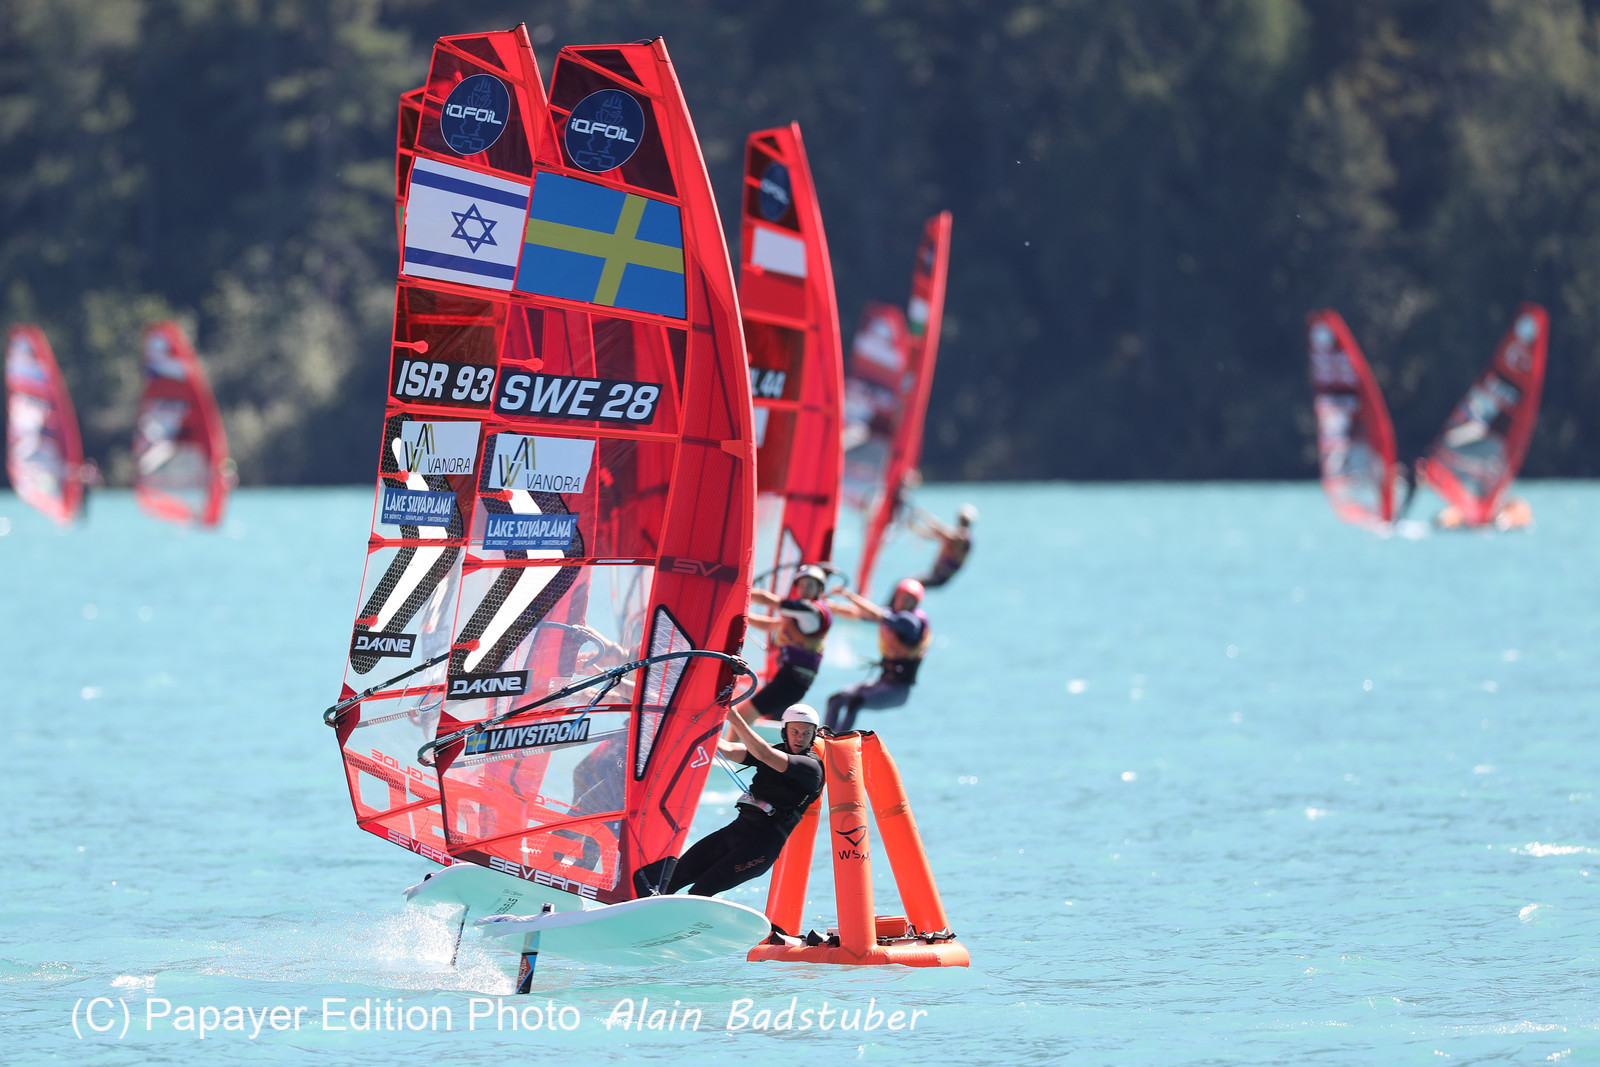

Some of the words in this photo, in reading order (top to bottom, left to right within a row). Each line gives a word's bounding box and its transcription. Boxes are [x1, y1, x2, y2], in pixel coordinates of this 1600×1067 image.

[396, 360, 450, 398] ISR
[451, 365, 497, 402] 93
[500, 374, 602, 416] SWE
[600, 383, 659, 420] 28
[428, 458, 471, 473] VANORA
[526, 473, 581, 491] VANORA
[385, 492, 407, 513] LAKE
[406, 495, 452, 516] SILVAPLANA
[487, 518, 516, 538] LAKE
[515, 519, 572, 539] SILVAPLANA
[489, 855, 598, 900] SEVERNE
